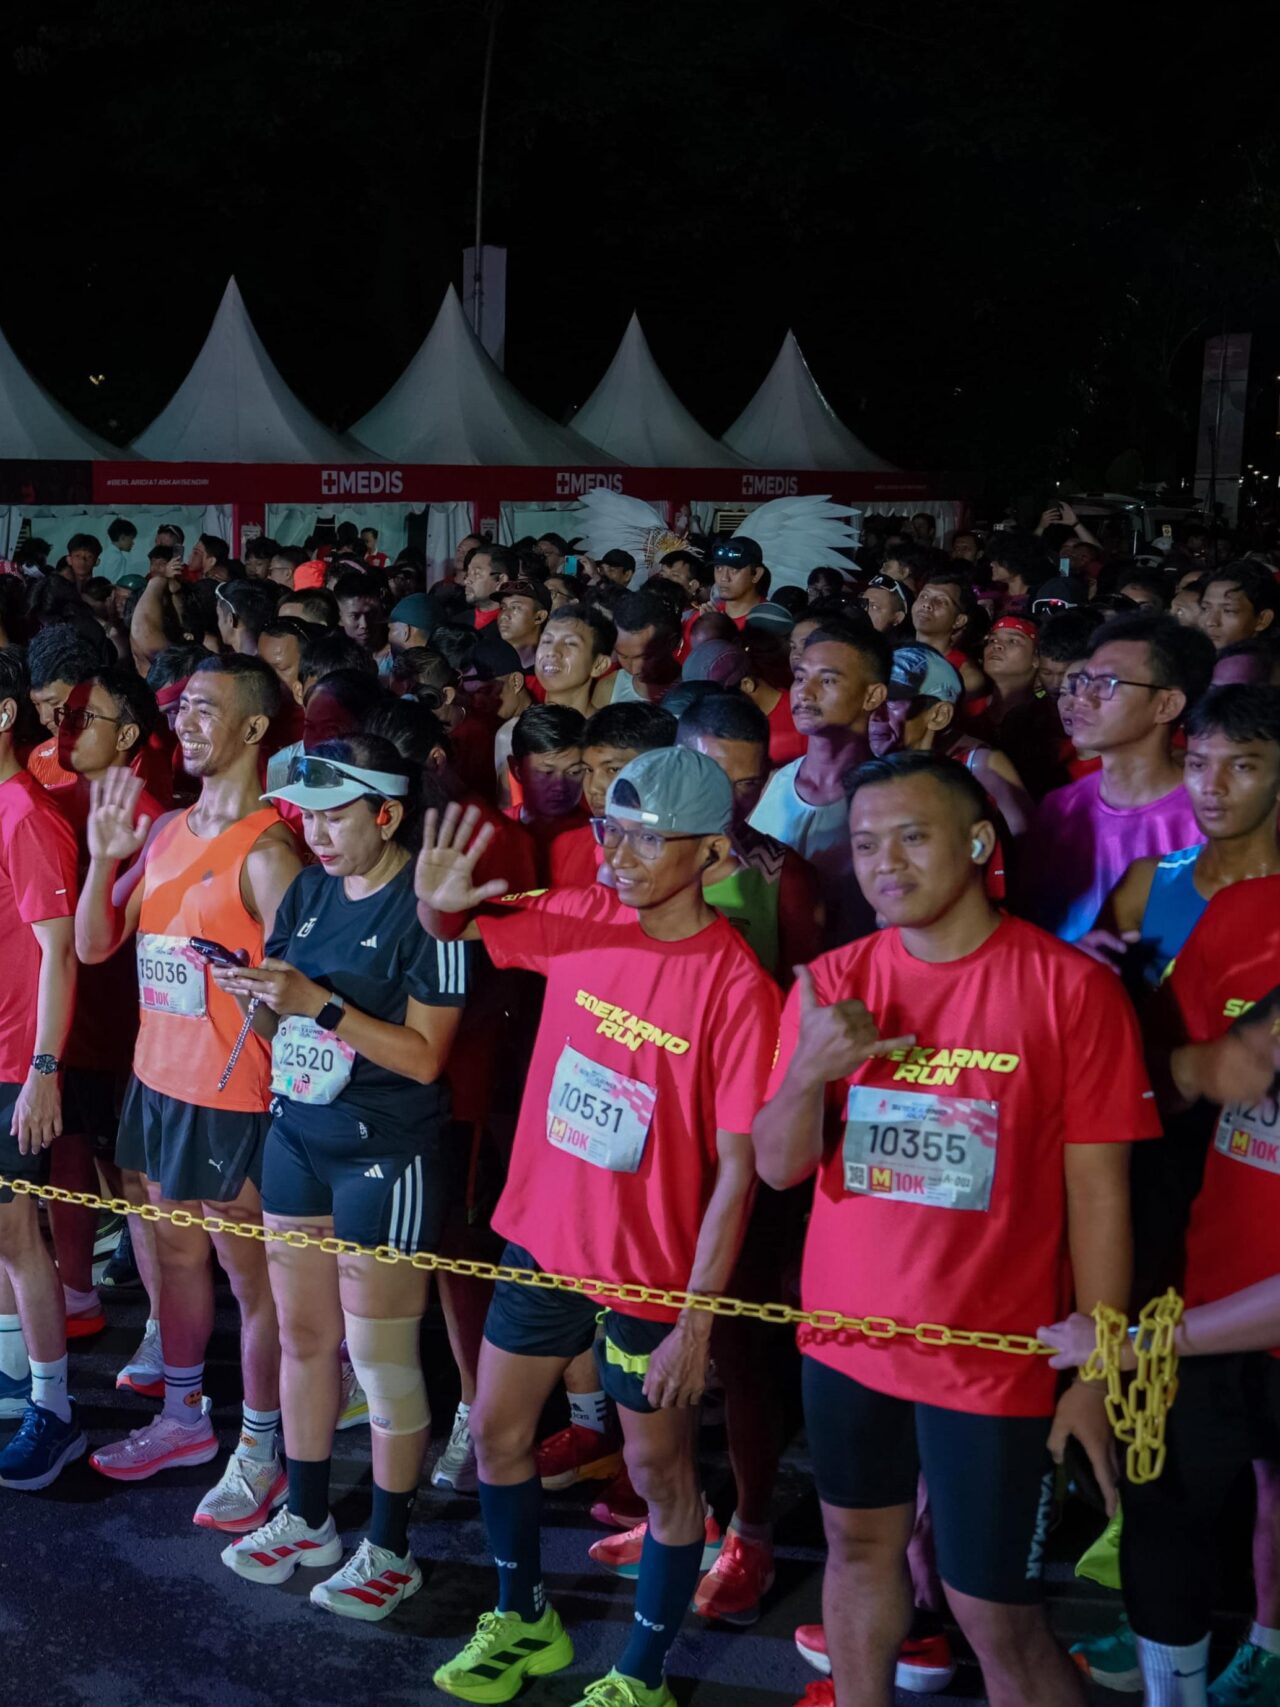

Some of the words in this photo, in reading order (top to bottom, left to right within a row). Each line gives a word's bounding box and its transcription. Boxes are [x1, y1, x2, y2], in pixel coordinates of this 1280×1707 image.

[339, 471, 403, 494] MEDIS
[571, 473, 624, 494] MEDIS
[752, 477, 798, 495] MEDIS
[139, 957, 187, 985] 15036
[155, 991, 169, 1006] 10K
[575, 989, 690, 1056] SOEKARNO
[595, 1017, 645, 1052] RUN
[892, 1062, 962, 1086] RUN
[558, 1082, 624, 1134] 10531
[567, 1127, 590, 1152] 10K
[868, 1124, 968, 1166] 10355
[894, 1172, 926, 1194] 10K
